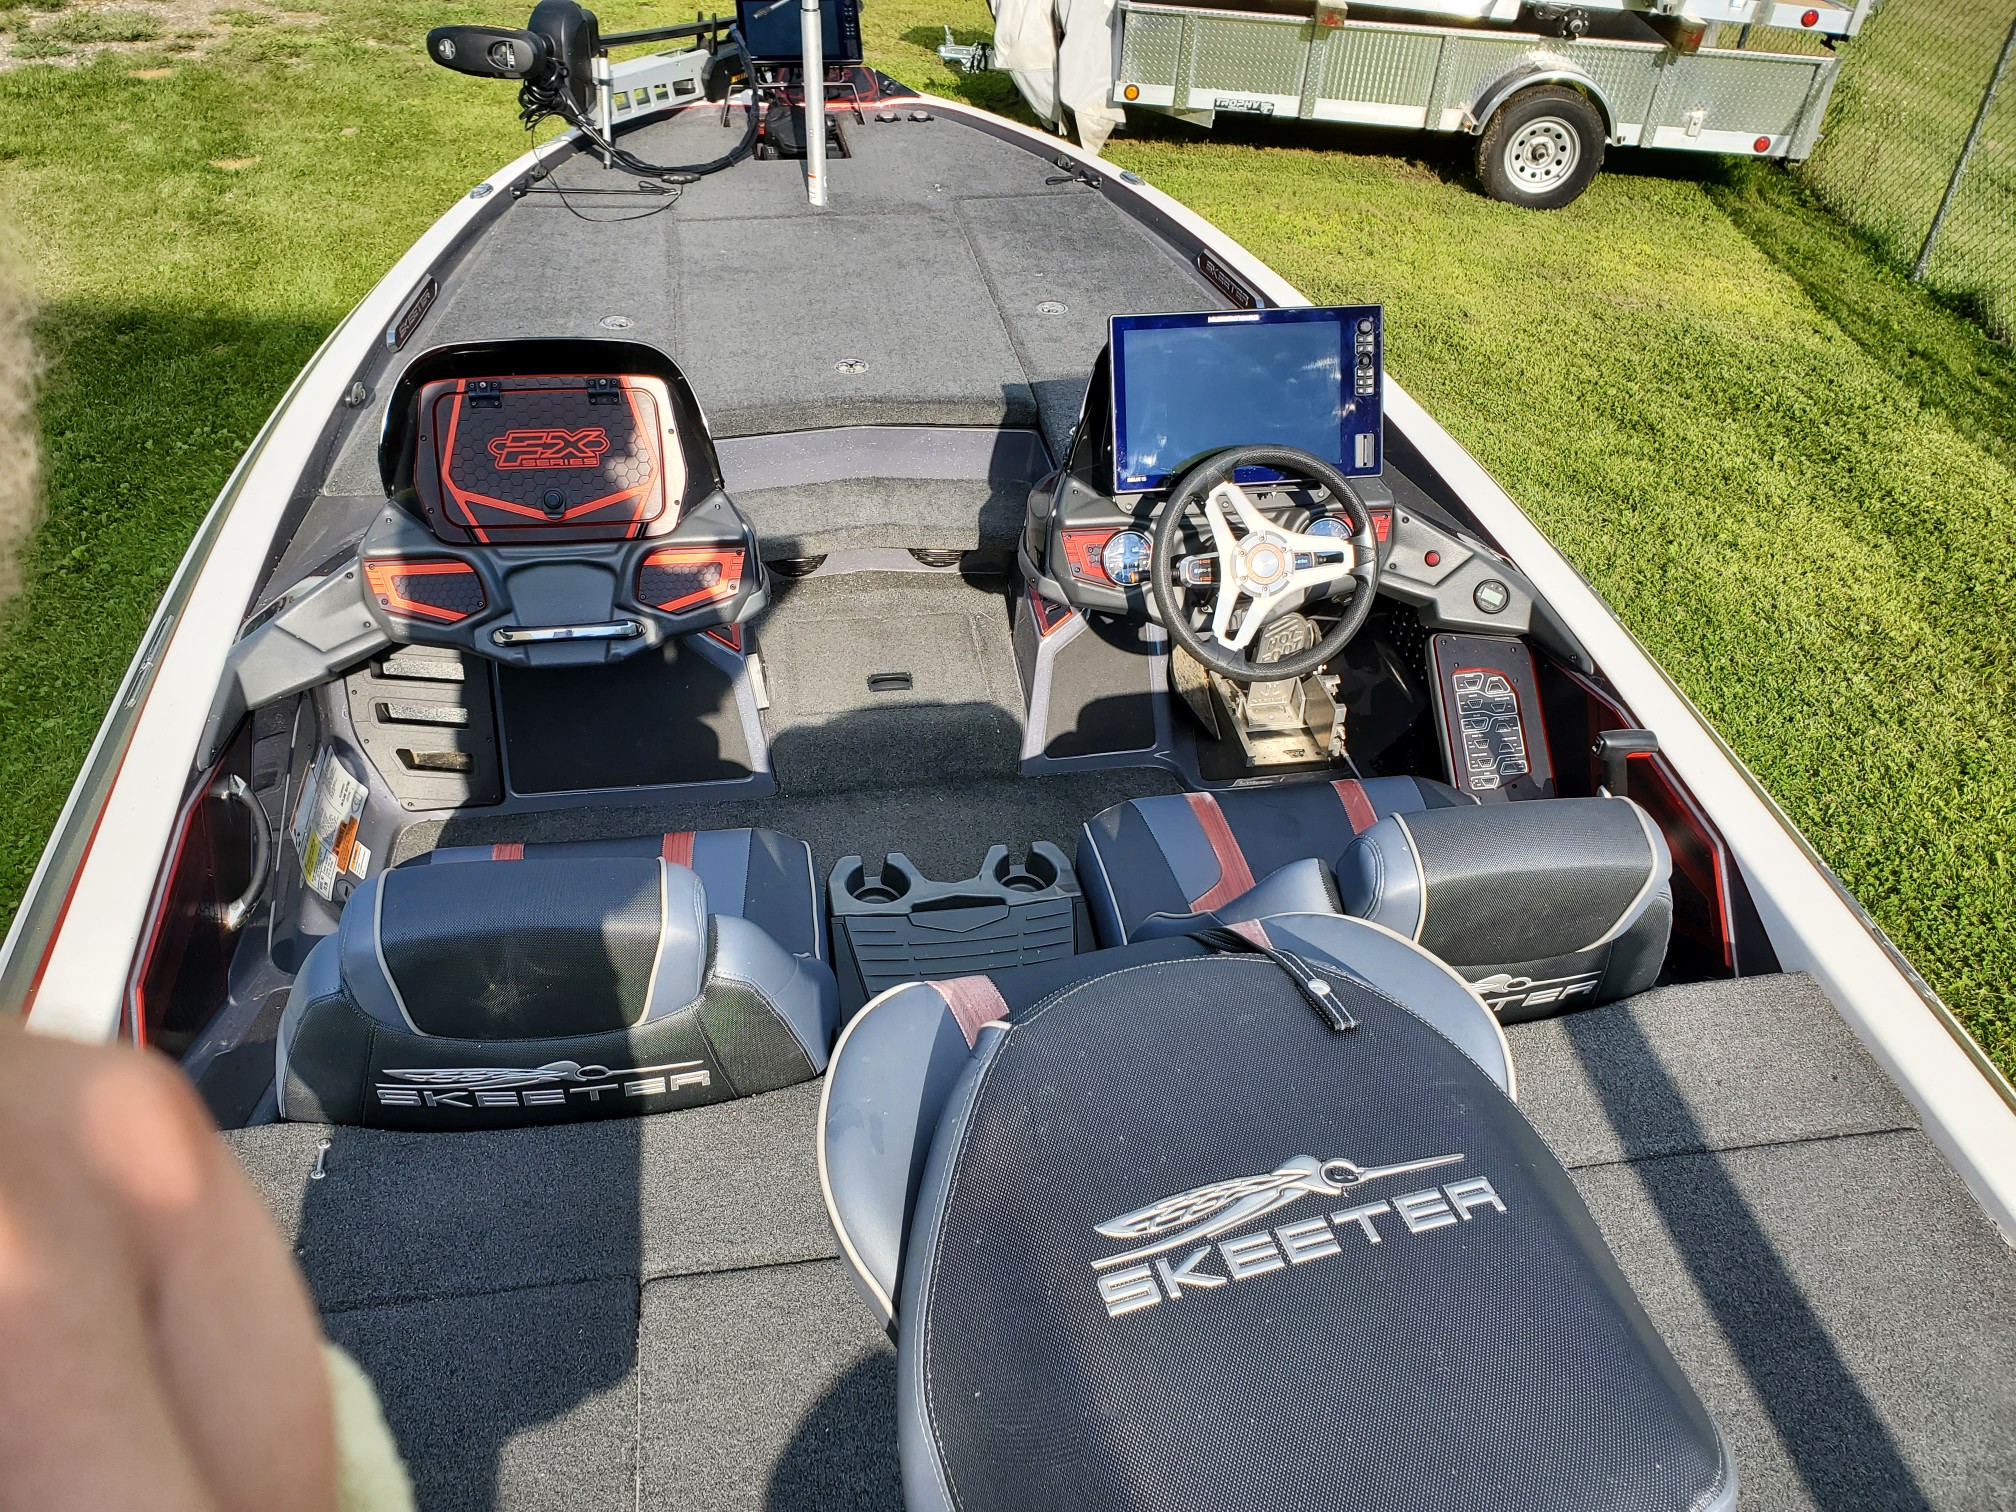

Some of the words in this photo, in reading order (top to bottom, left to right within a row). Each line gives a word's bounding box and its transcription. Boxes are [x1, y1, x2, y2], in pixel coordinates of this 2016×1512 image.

[1216, 98, 1261, 109] TROPHY
[1206, 260, 1249, 306] SKEETER
[499, 431, 602, 466] FX
[522, 458, 597, 467] SERIES
[1267, 628, 1300, 651] HOT
[377, 1070, 711, 1107] SKEETER
[1097, 1176, 1508, 1318] SKEETER
